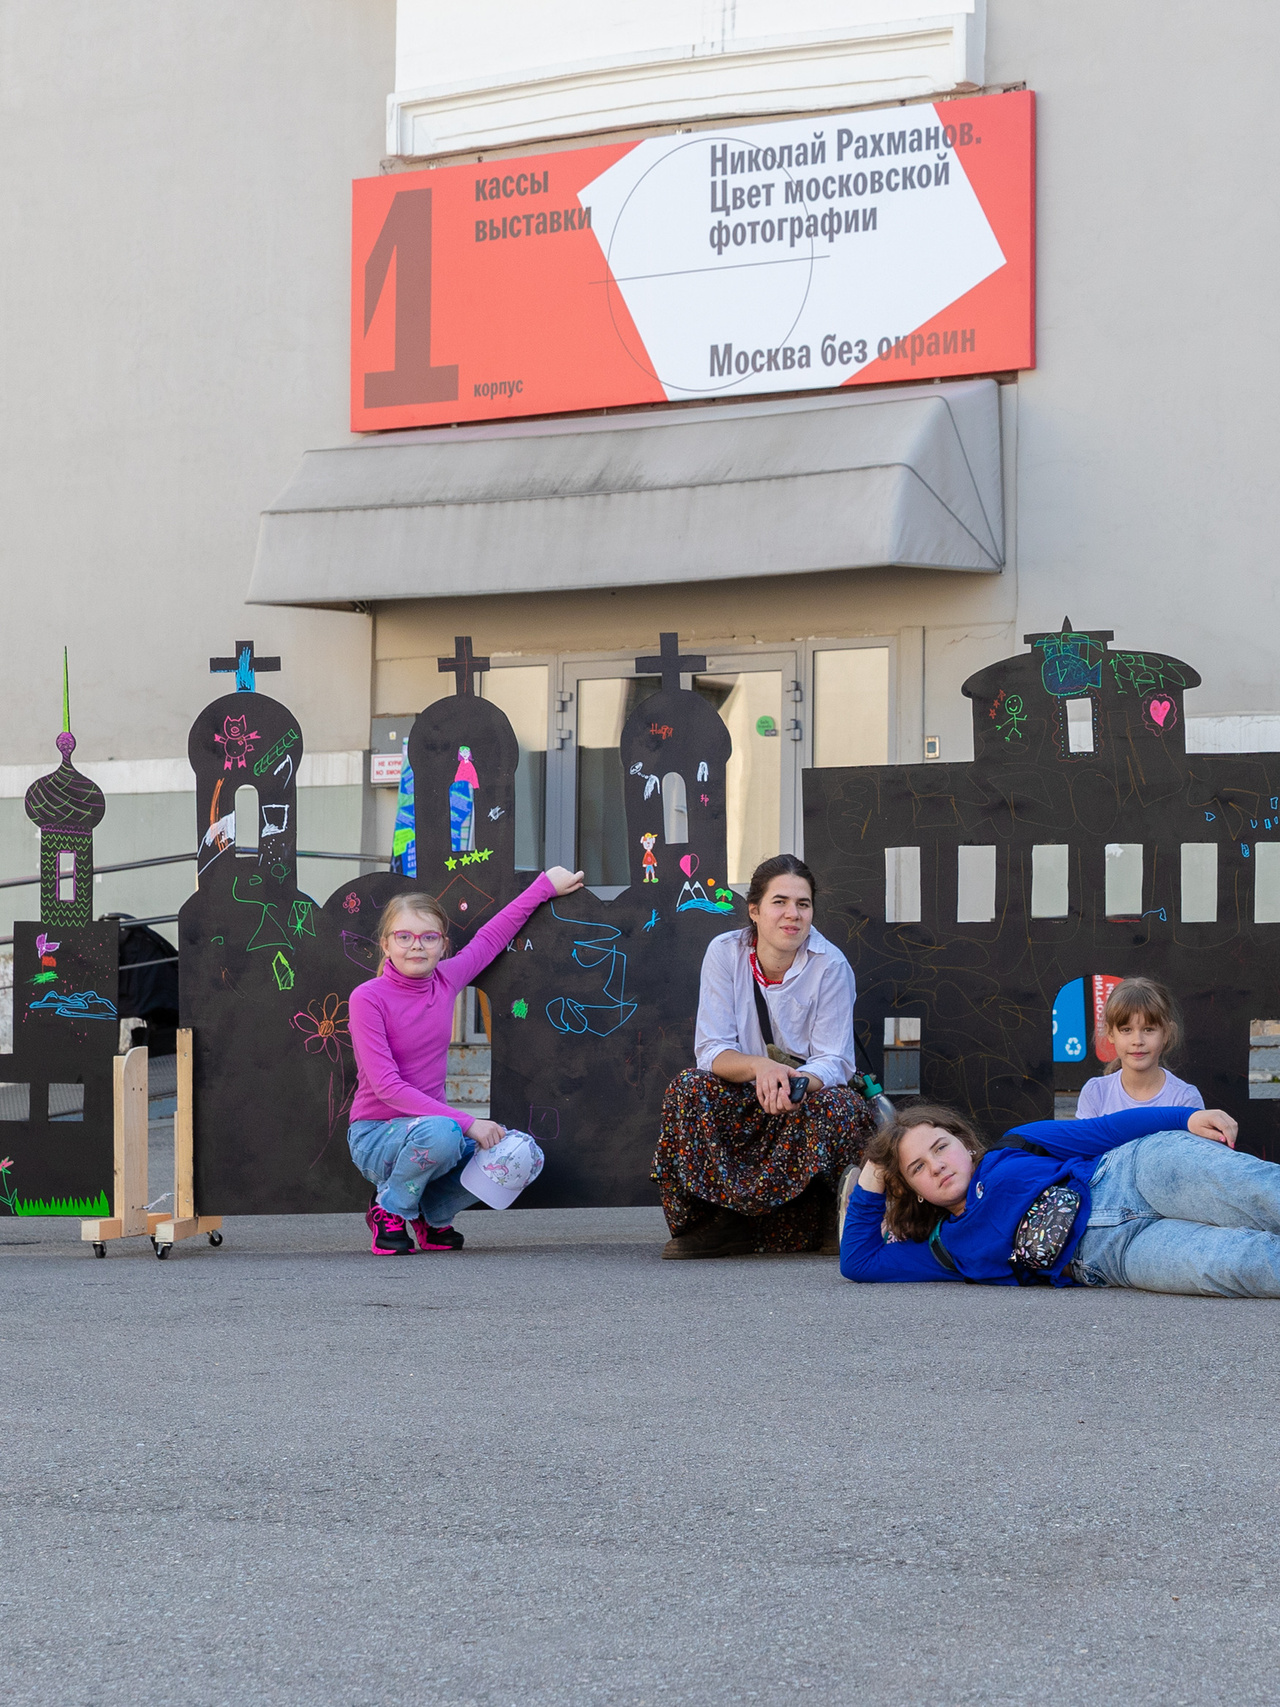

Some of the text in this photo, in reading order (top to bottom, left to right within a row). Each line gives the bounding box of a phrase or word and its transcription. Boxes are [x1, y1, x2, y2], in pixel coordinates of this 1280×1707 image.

[710, 122, 982, 177] Николай Рахманов.
[475, 171, 549, 202] кассы
[711, 152, 950, 217] Цвет московской
[475, 206, 592, 242] выставки
[709, 207, 878, 255] фотографии
[364, 188, 459, 409] 1
[709, 328, 976, 377] Москва без окраин
[474, 380, 524, 399] корпус
[1094, 974, 1105, 1037] НЕСОРТИР
